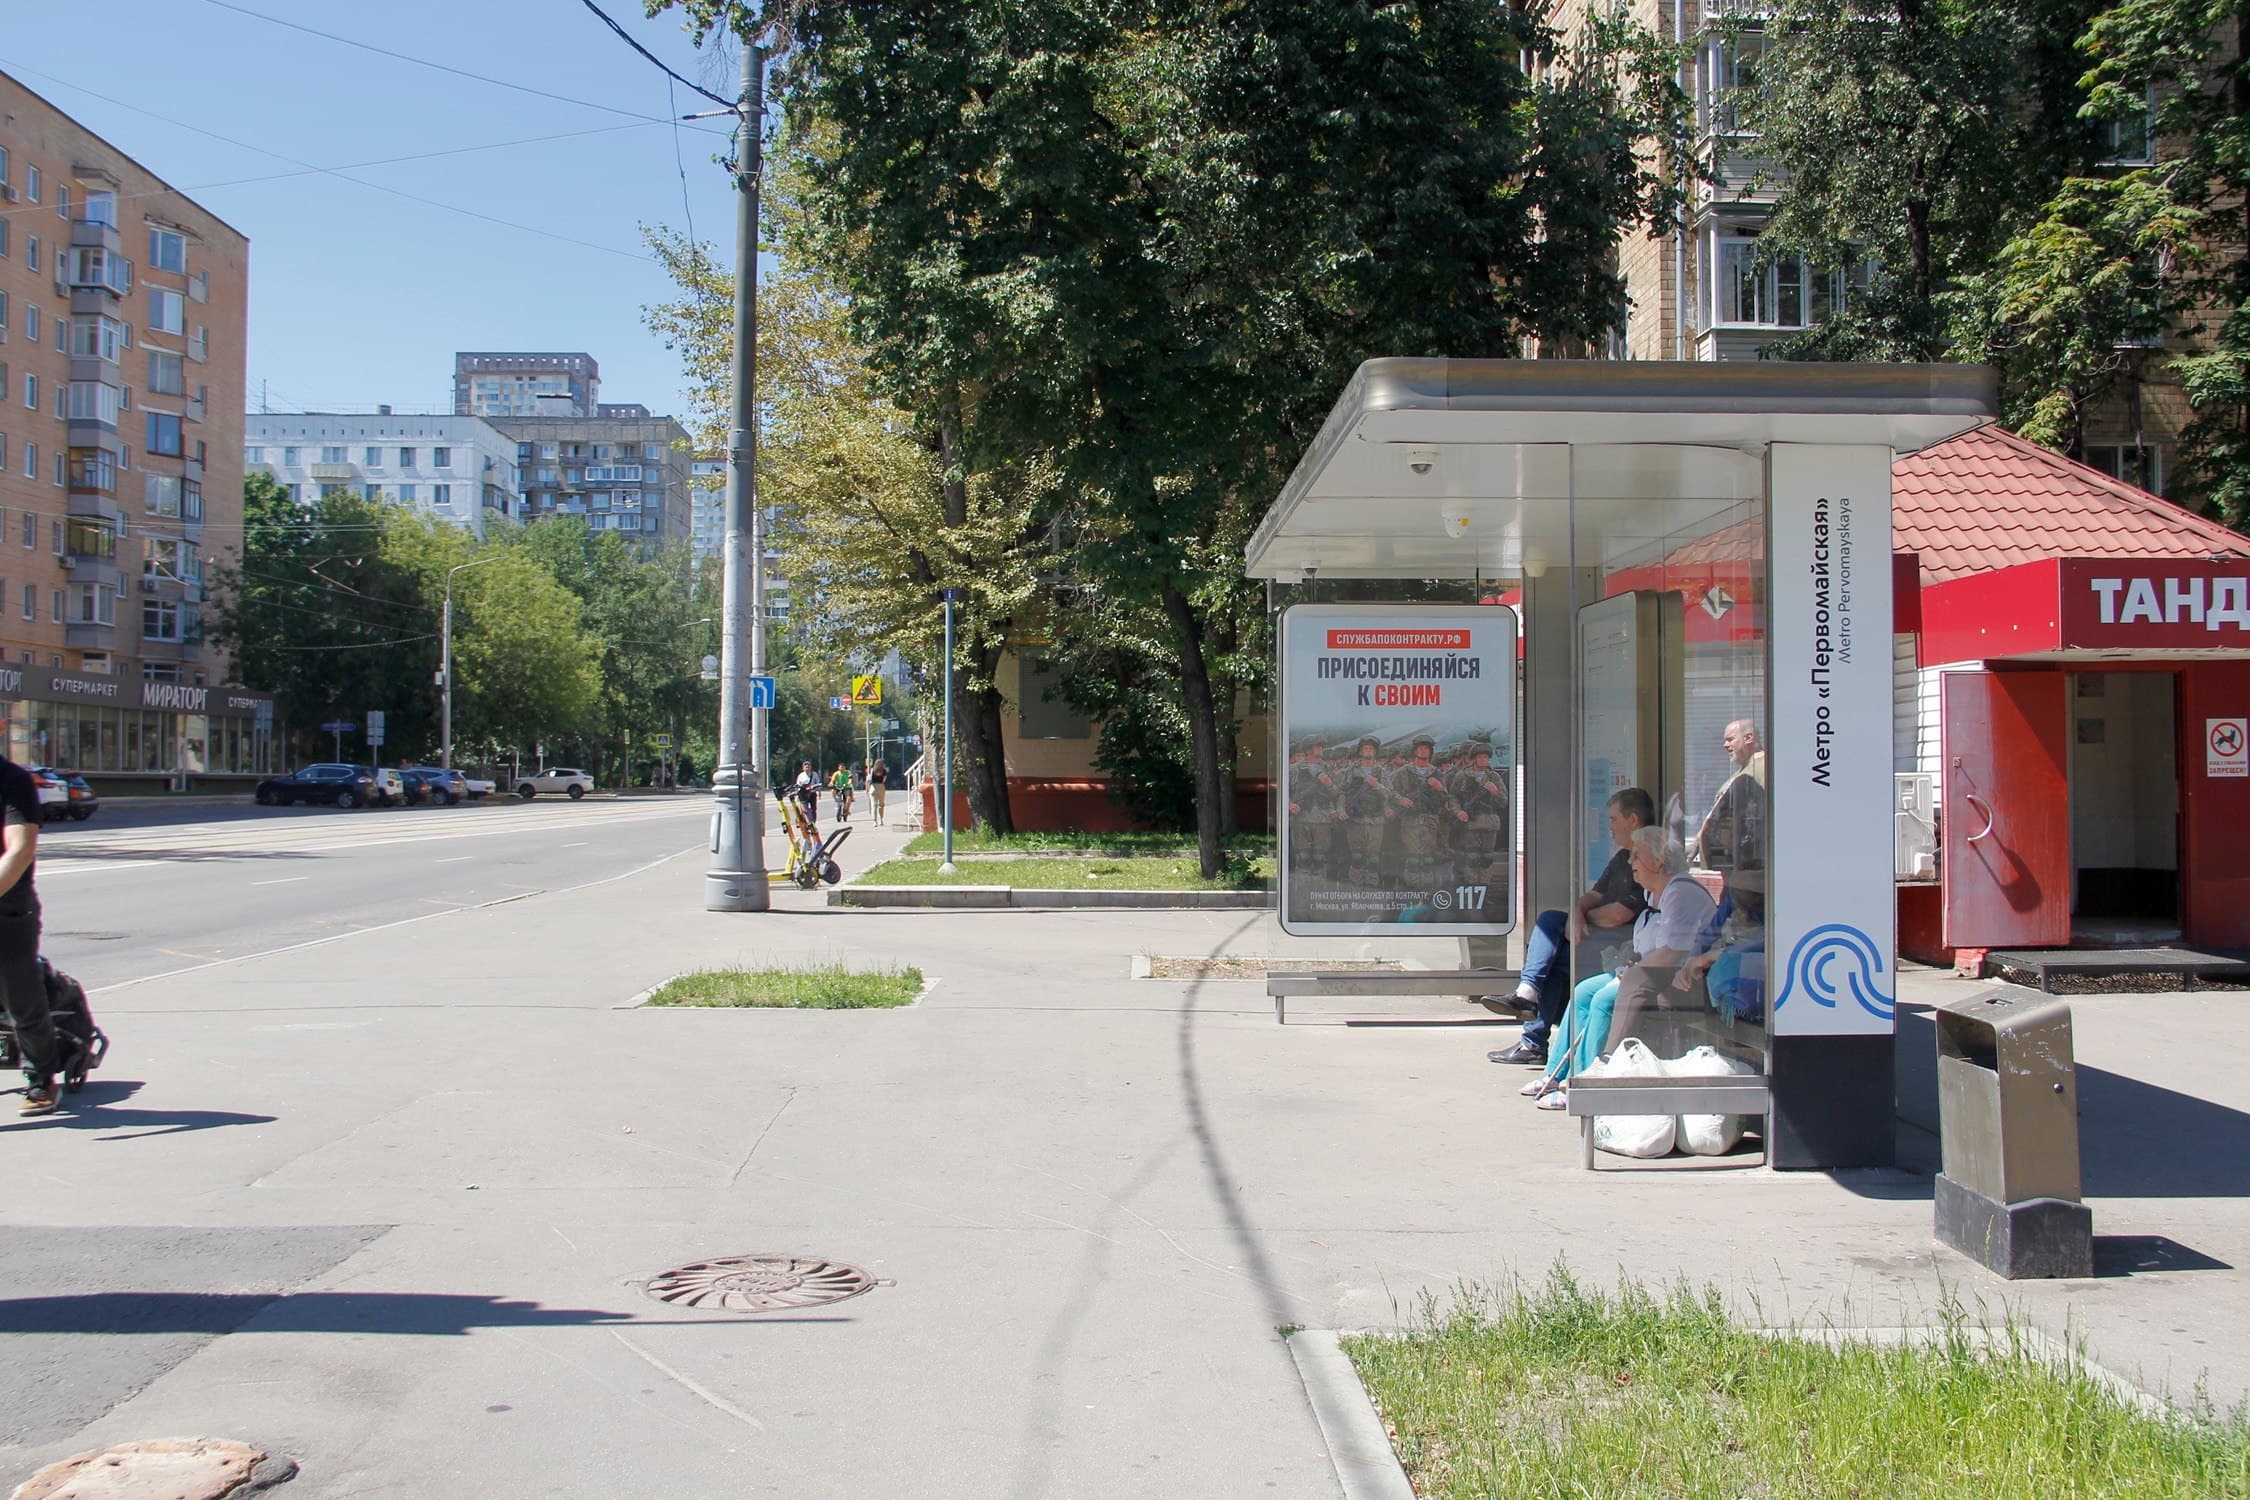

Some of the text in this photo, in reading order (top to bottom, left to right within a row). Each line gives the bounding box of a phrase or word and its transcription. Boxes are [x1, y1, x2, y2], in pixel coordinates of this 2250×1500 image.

[1836, 497, 1853, 664] Metro Pervomayskaya
[2091, 577, 2250, 631] ТАНД
[1336, 633, 1462, 645] СЛУЖБАПОКОНТРАКТУ.РФ
[1810, 497, 1835, 787] Метро «Первомайская»
[1317, 652, 1480, 681] ПРИСОЕДИНЯЙСЯ
[52, 678, 118, 696] СУПЕРМАРКЕТ
[143, 683, 208, 710] МИРАТОРГ
[1357, 684, 1440, 706] К СВОИМ
[1456, 886, 1487, 910] 117
